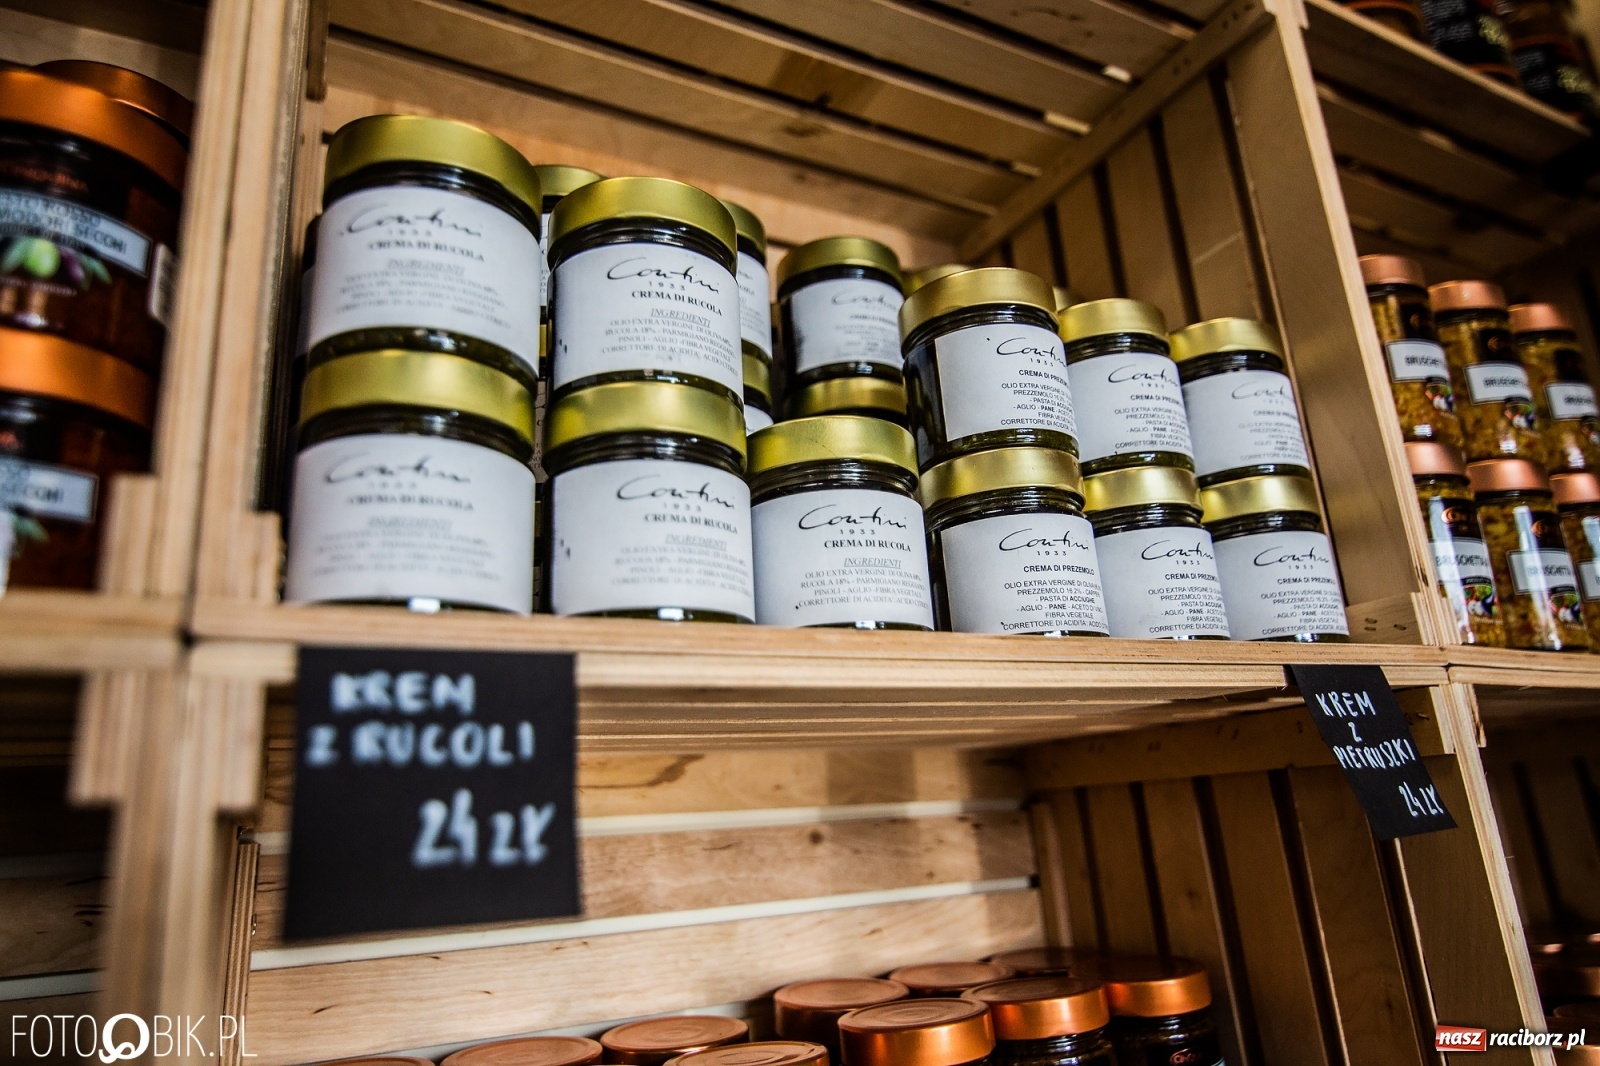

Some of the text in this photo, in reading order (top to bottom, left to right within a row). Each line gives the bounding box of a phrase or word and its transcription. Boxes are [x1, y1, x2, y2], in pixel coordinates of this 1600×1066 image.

[368, 239, 485, 262] CREMA DI RUCOLA
[607, 257, 720, 294] Contini
[648, 281, 686, 291] 1933
[631, 290, 722, 316] CREMA DI RUCOLA
[651, 308, 711, 328] INGREDIENTI
[1018, 369, 1043, 377] CREMA
[1040, 405, 1055, 413] PANE
[616, 474, 735, 510] Contini
[644, 513, 738, 534] CREMA DI RUCOLA
[799, 504, 907, 530] Contini
[824, 539, 911, 552] CREMA DI RUCOLA
[999, 528, 1089, 551] Contini
[844, 557, 902, 569] INGREDIENTI
[1023, 565, 1052, 573] CREMA
[826, 569, 853, 577] EXTRA
[800, 579, 834, 588] RUCOLA
[856, 578, 901, 586] PARMIGIANO
[1004, 582, 1022, 590] OLIO
[814, 588, 841, 596] PINOLI
[1017, 587, 1065, 596] PREZZEMOLO
[798, 596, 849, 607] CORRETTORE
[1066, 612, 1094, 620] VEGETALE
[1003, 620, 1054, 631] CORRETTORE
[1149, 624, 1194, 633] CORRETTORE
[330, 671, 475, 714] KREM
[1315, 690, 1376, 718] KREM
[353, 720, 536, 769] RUCOLI
[1333, 738, 1416, 770] PIETRUSZKI
[1398, 781, 1428, 817] 24
[412, 788, 479, 867] 24
